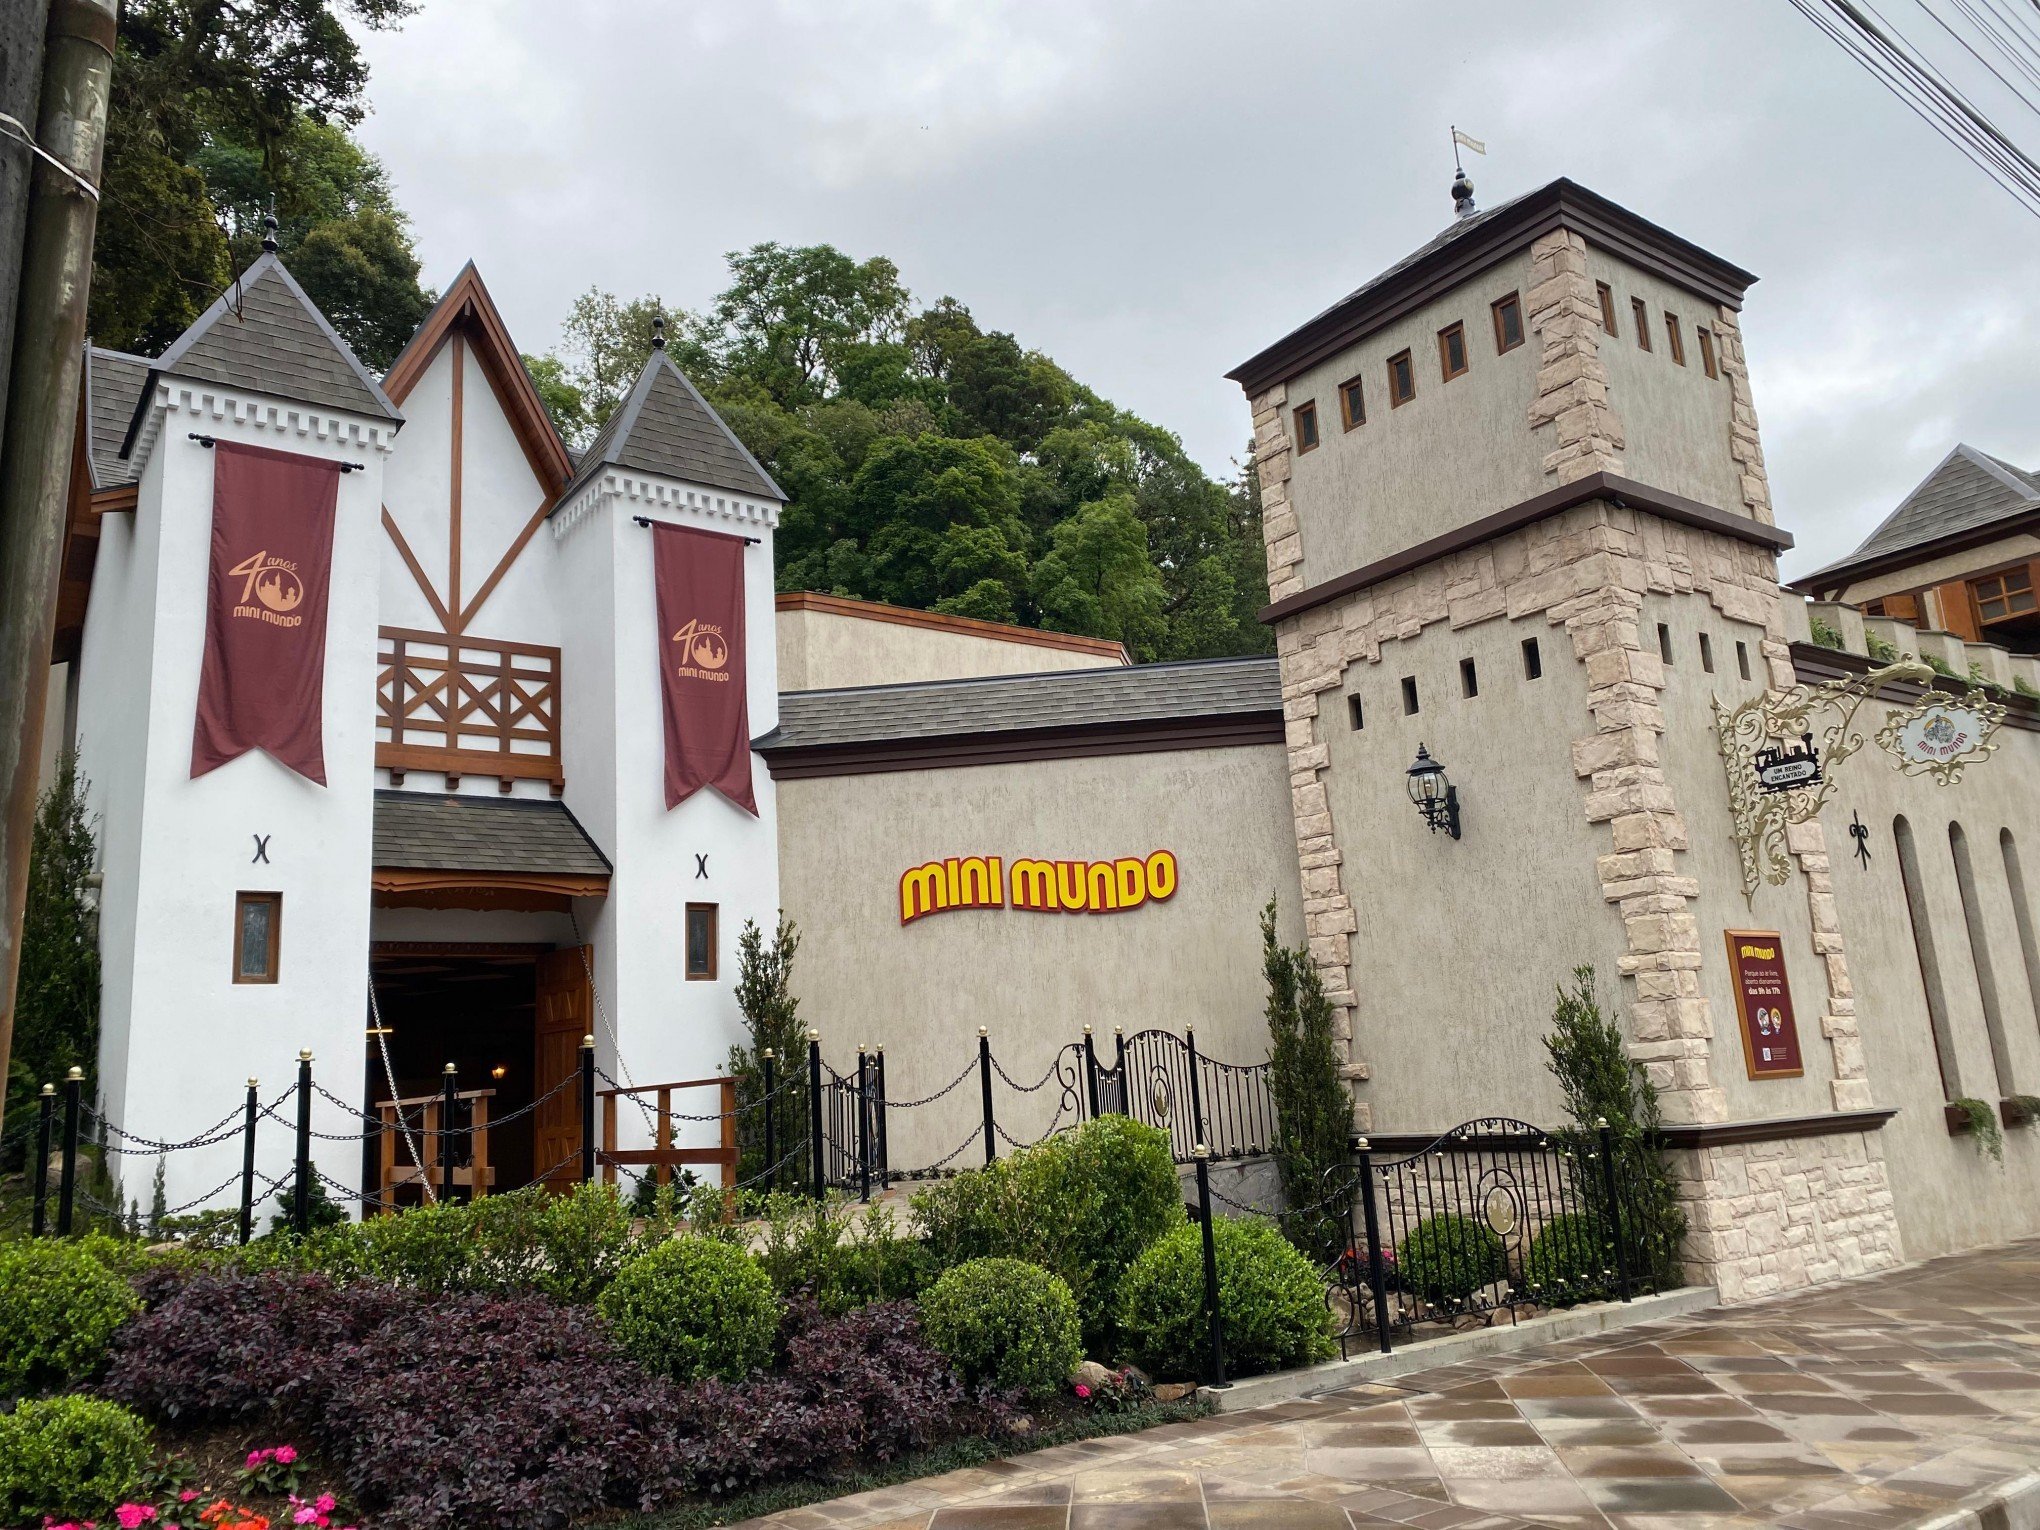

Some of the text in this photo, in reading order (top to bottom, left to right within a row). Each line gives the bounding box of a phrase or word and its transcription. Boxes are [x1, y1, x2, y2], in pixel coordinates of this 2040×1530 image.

[267, 556, 298, 571] anos
[233, 605, 302, 627] MINI MUNDO
[698, 623, 722, 633] anos
[678, 667, 729, 682] MINI MUNDO
[1917, 732, 1968, 756] MINI MUNDO
[1770, 770, 1807, 781] ENCANTADO
[1784, 764, 1802, 772] REINO
[900, 849, 1178, 926] MINI MUNDO
[1741, 945, 1775, 960] MINI MUNDO
[1748, 987, 1758, 995] das
